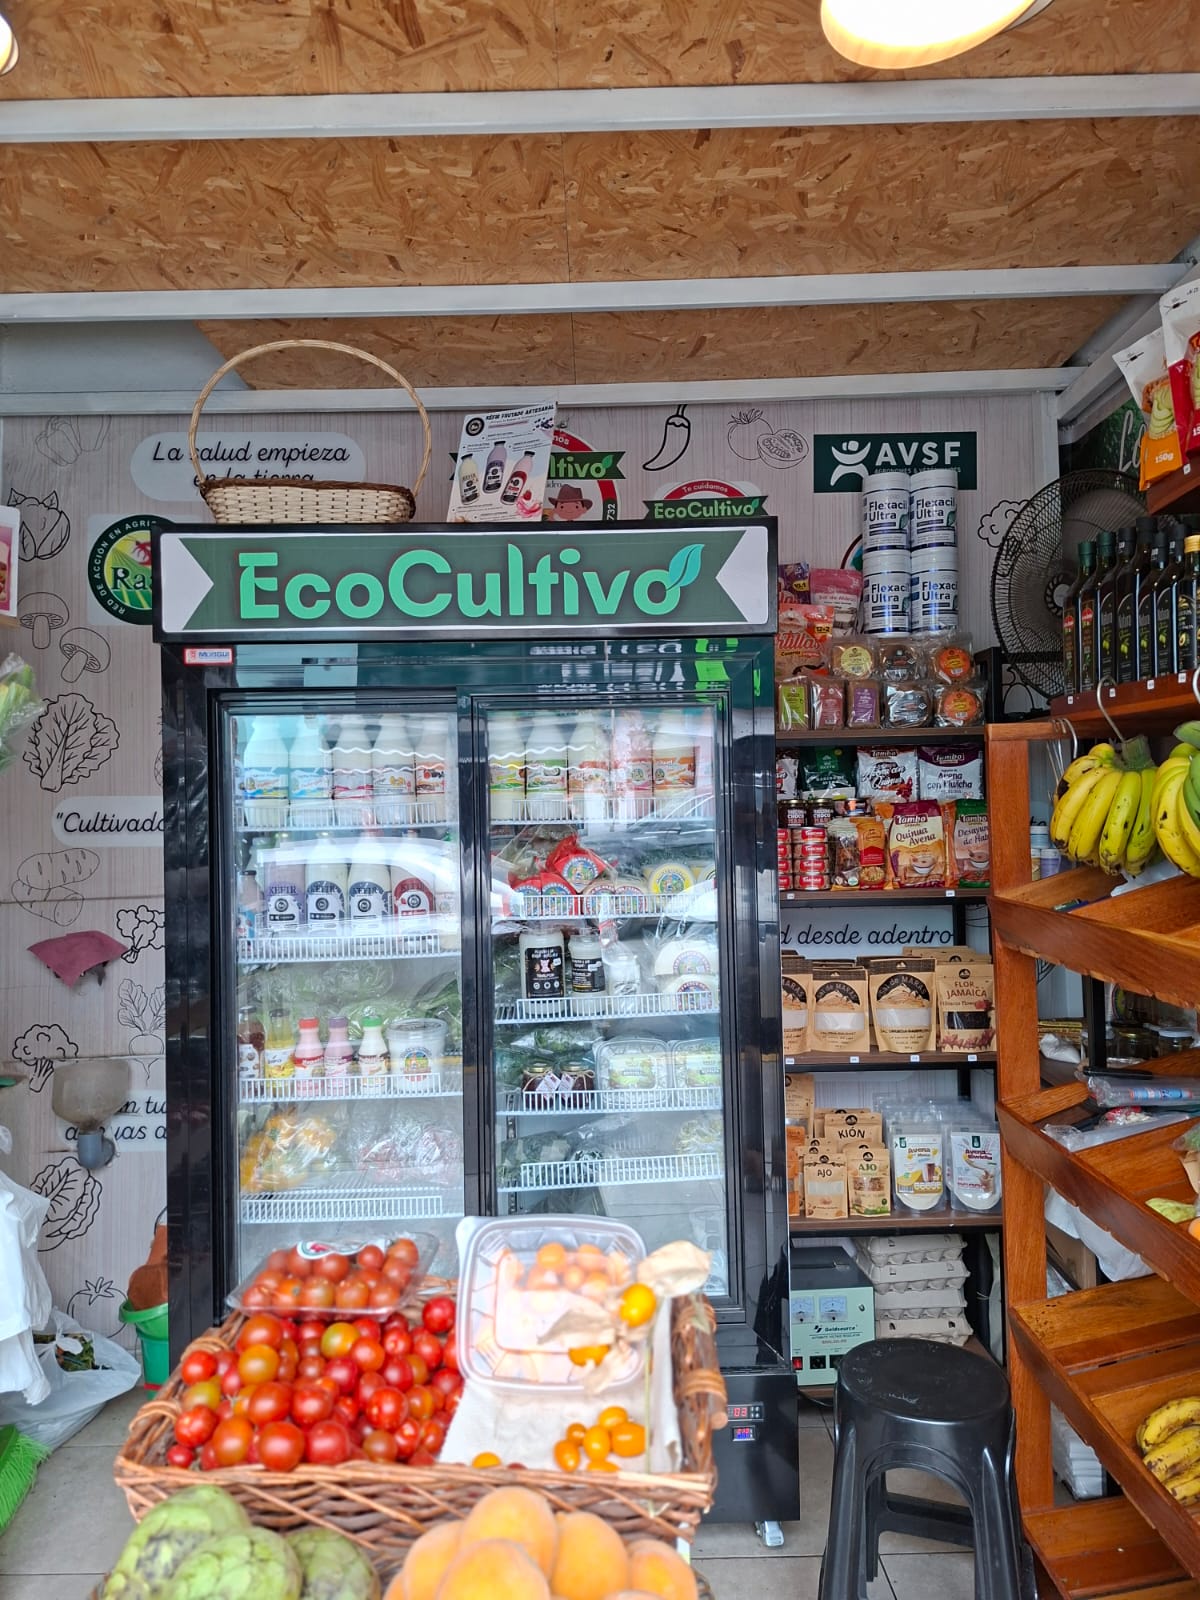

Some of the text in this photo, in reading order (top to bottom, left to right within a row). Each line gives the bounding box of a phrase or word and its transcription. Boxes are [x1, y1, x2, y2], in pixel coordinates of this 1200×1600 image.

[152, 441, 184, 461] La
[258, 443, 350, 468] empieza
[875, 441, 961, 467] AVSF
[693, 483, 728, 493] cuidamos
[654, 499, 758, 519] EcoCultivo
[916, 509, 944, 519] Ultra
[869, 511, 897, 522] Ultra
[125, 520, 157, 530] AGRI
[109, 529, 122, 540] EN
[238, 543, 682, 619] EcoCultivo
[97, 584, 107, 597] DE
[922, 591, 951, 601] Ultra
[871, 594, 900, 604] Ultra
[108, 599, 126, 615] RED
[897, 815, 927, 825] Tambo
[895, 827, 929, 843] Quinua
[909, 833, 937, 847] Avena
[797, 923, 862, 945] desde
[867, 923, 954, 945] adentro
[946, 988, 987, 999] JAMAICA
[838, 1127, 866, 1139] KIÓN
[817, 1168, 833, 1178] AJO
[858, 1163, 878, 1172] AJO
